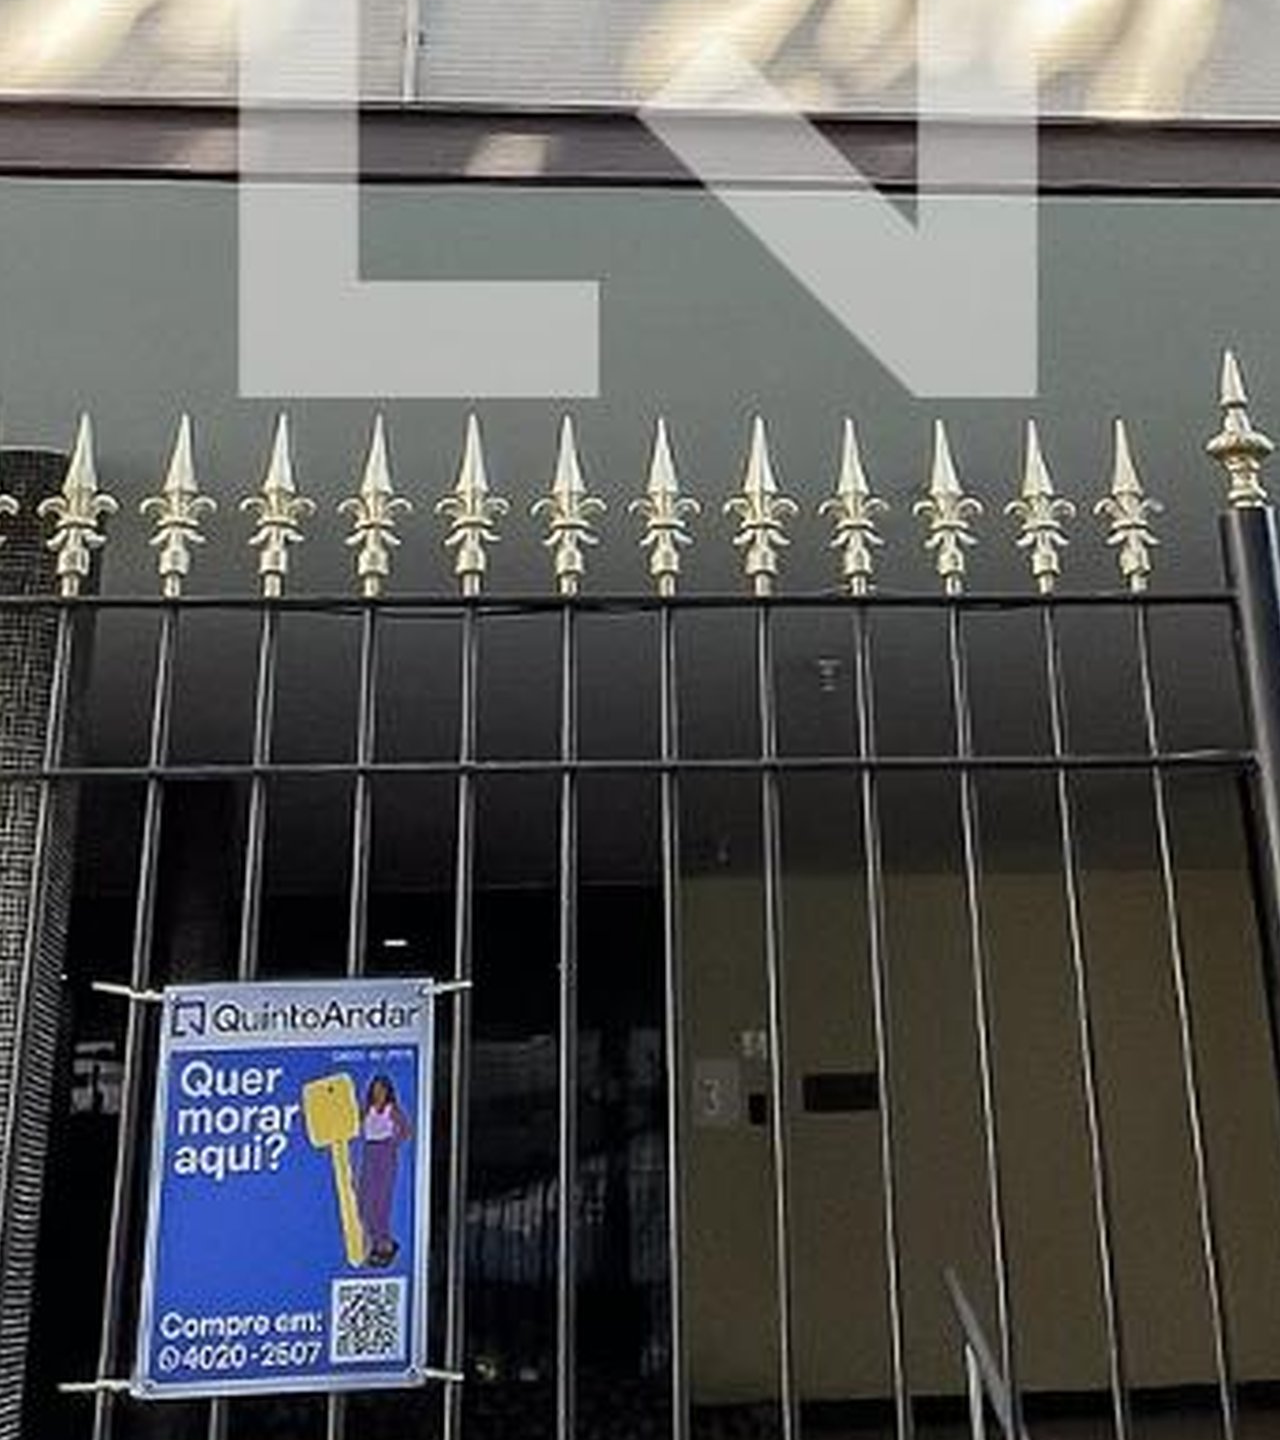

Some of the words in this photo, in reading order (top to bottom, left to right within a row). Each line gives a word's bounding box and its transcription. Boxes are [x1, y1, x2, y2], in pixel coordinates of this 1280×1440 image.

[212, 1000, 420, 1033] QuintoAndar
[180, 1060, 283, 1099] Quer
[177, 1103, 300, 1135] morar
[173, 1132, 288, 1181] aqui?
